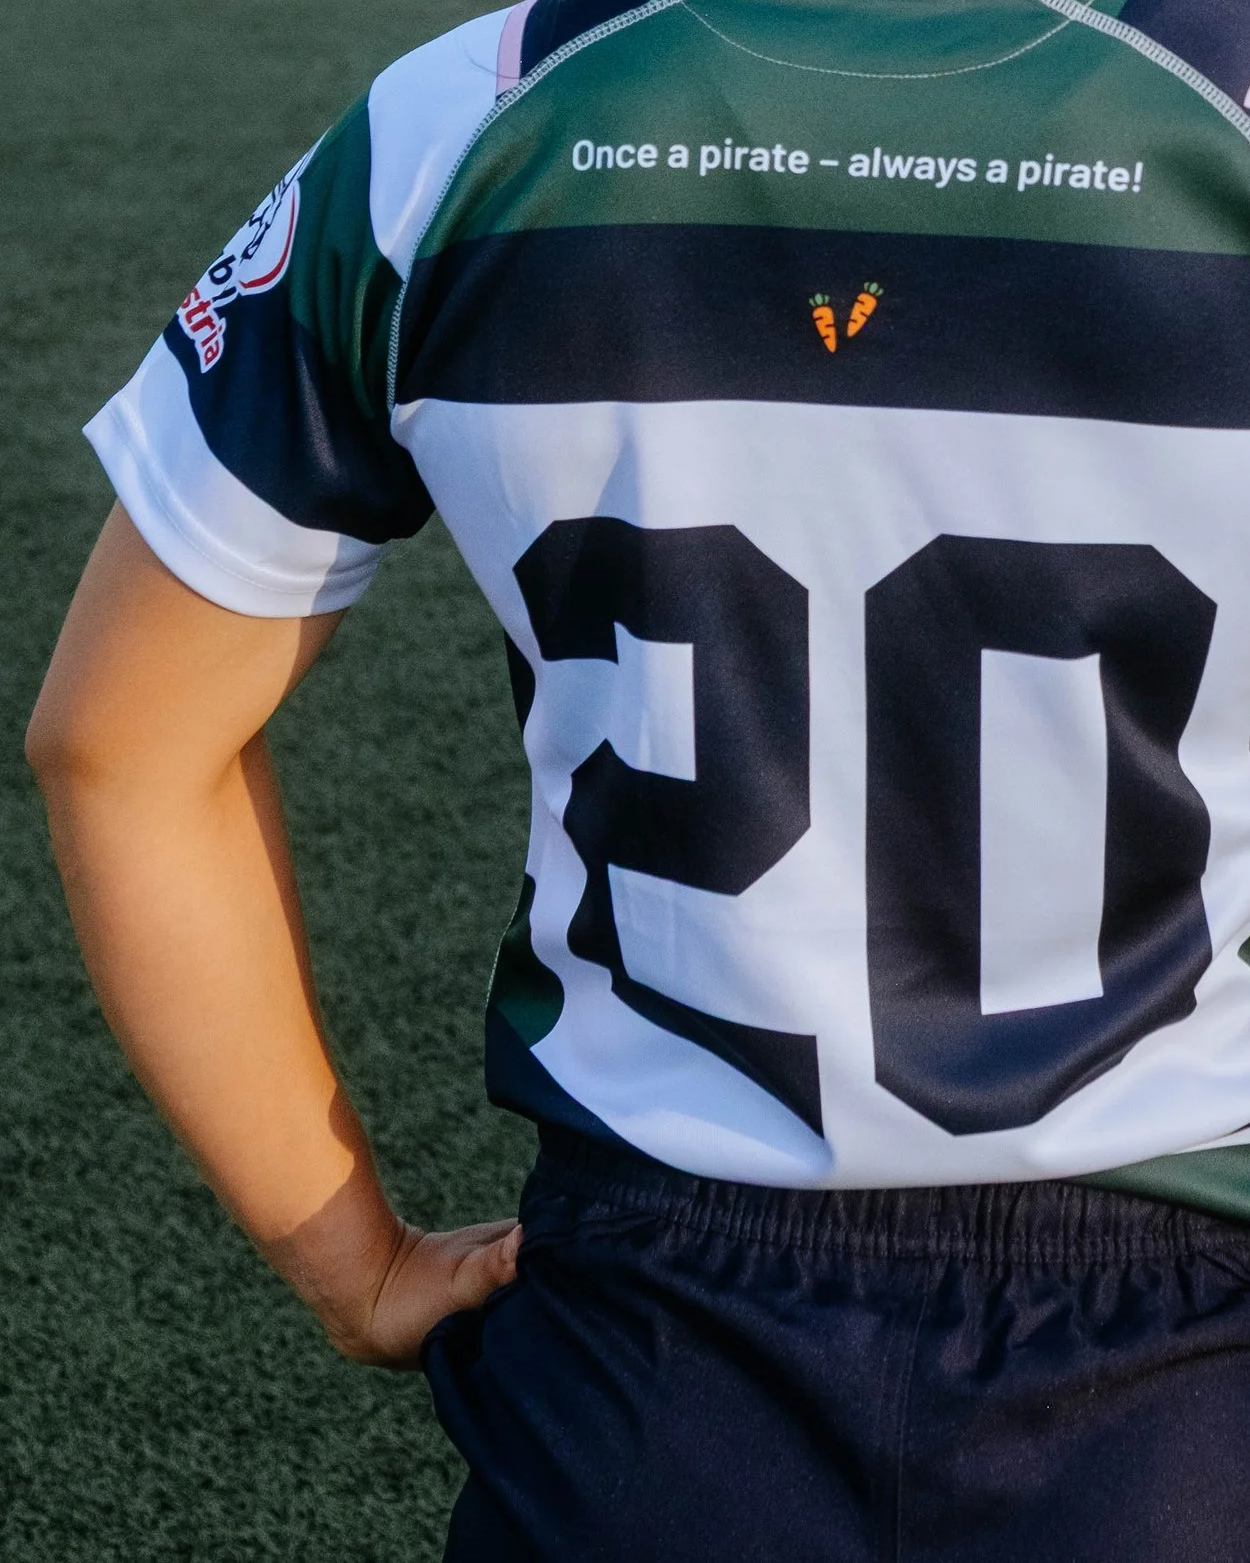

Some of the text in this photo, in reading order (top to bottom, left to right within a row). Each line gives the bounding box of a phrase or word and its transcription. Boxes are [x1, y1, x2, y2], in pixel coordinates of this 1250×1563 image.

[572, 140, 658, 171] Once
[667, 144, 689, 169] a
[699, 138, 810, 177] pirate
[848, 146, 978, 189] always
[985, 159, 1008, 184] a
[1017, 153, 1144, 193] pirate!
[513, 516, 1218, 1136] 20
